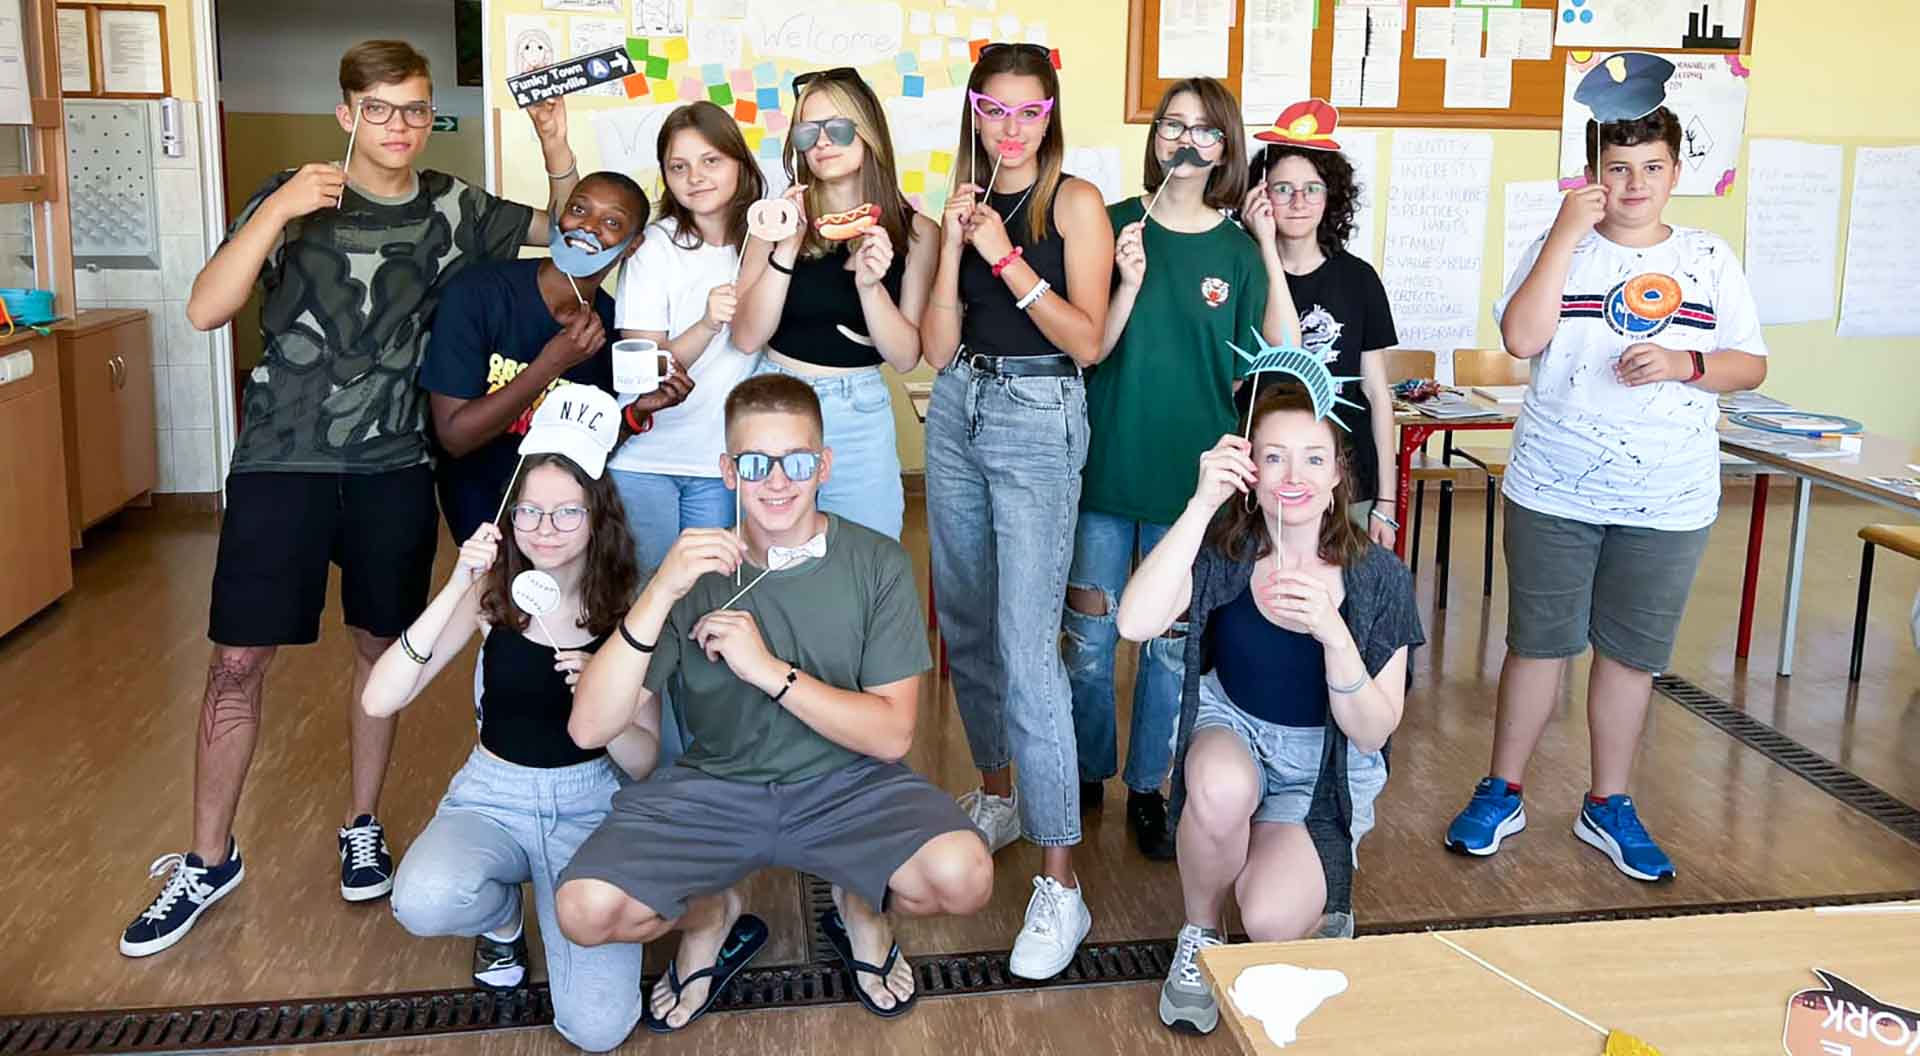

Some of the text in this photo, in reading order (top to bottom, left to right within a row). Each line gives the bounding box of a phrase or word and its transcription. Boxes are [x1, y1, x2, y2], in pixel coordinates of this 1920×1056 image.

[761, 11, 896, 54] Welcome
[511, 63, 584, 93] Funky Town
[593, 60, 607, 75] A
[517, 76, 588, 105] & Partyville
